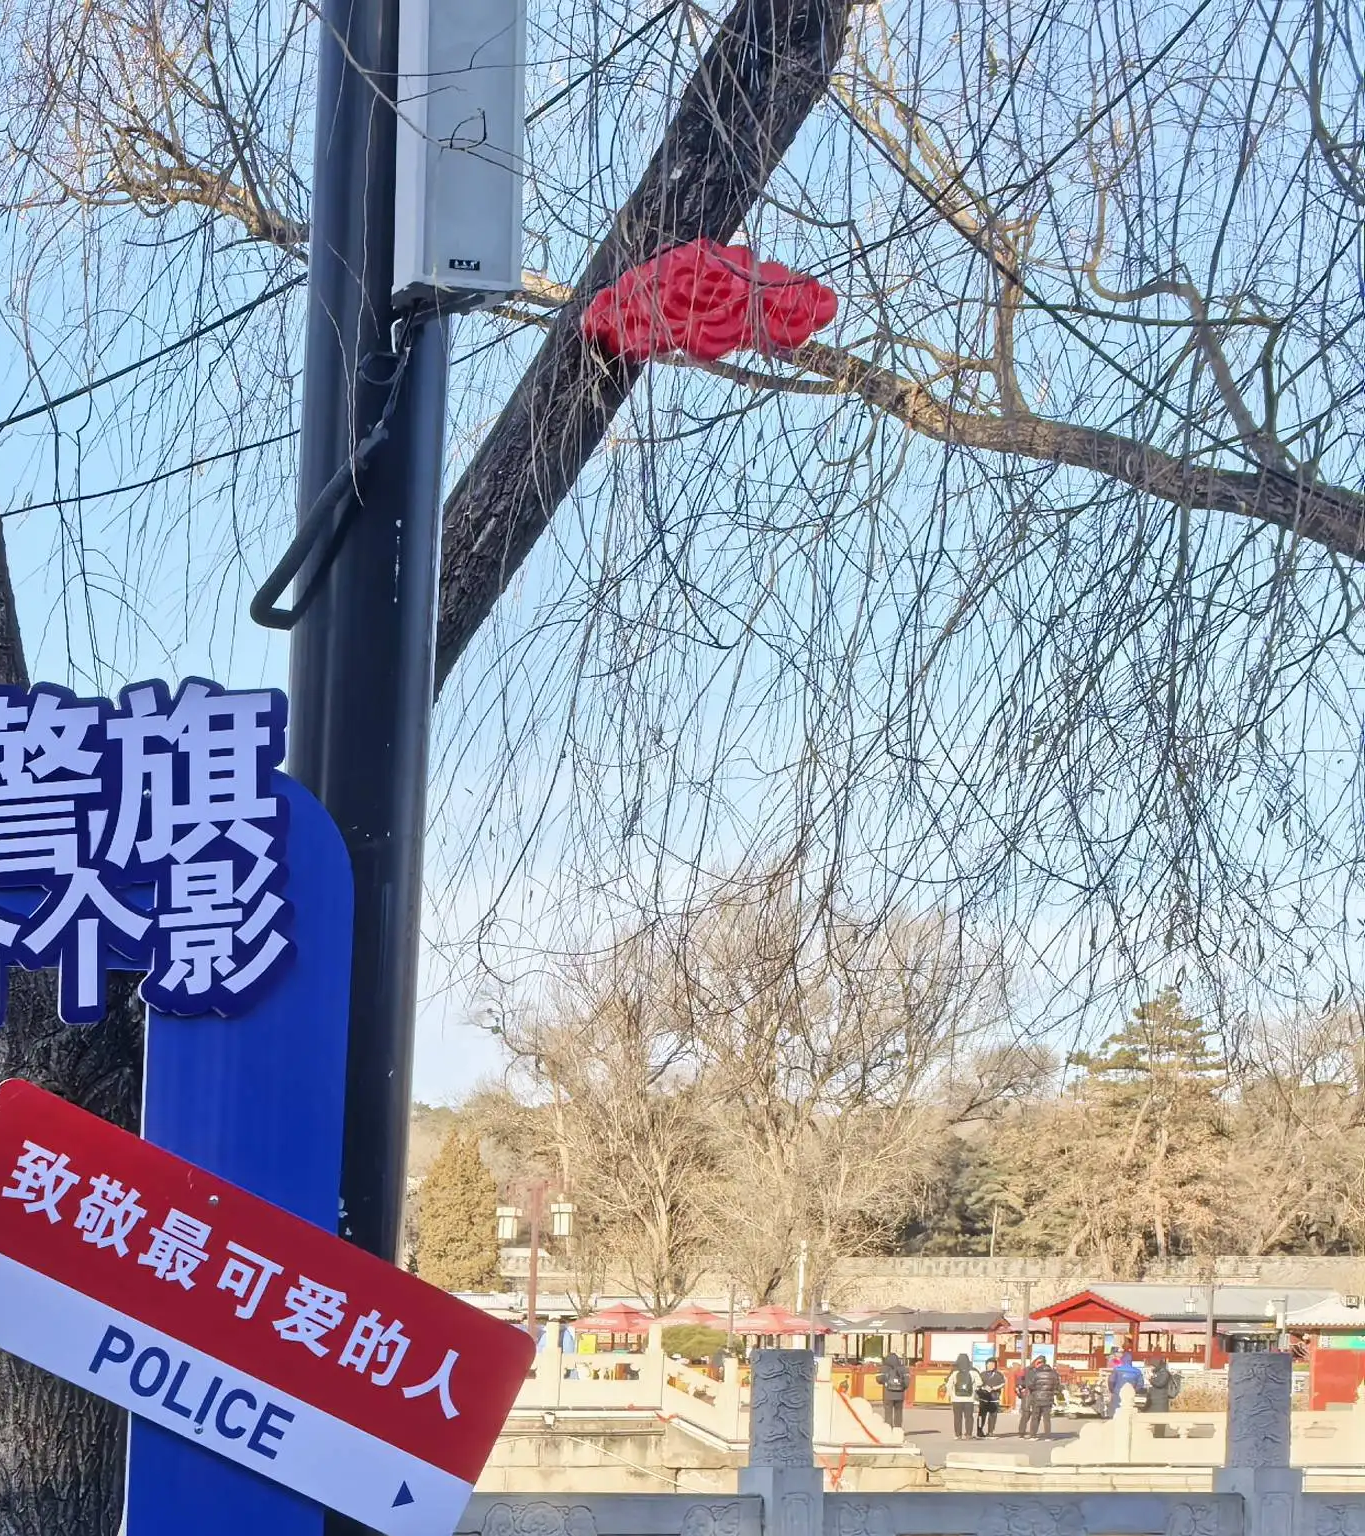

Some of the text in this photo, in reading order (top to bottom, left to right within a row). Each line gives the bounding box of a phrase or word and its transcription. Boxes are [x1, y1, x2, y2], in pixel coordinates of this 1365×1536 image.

[2, 1140, 461, 1420] 致敬最可爱的人
[88, 1325, 295, 1460] POLICE
